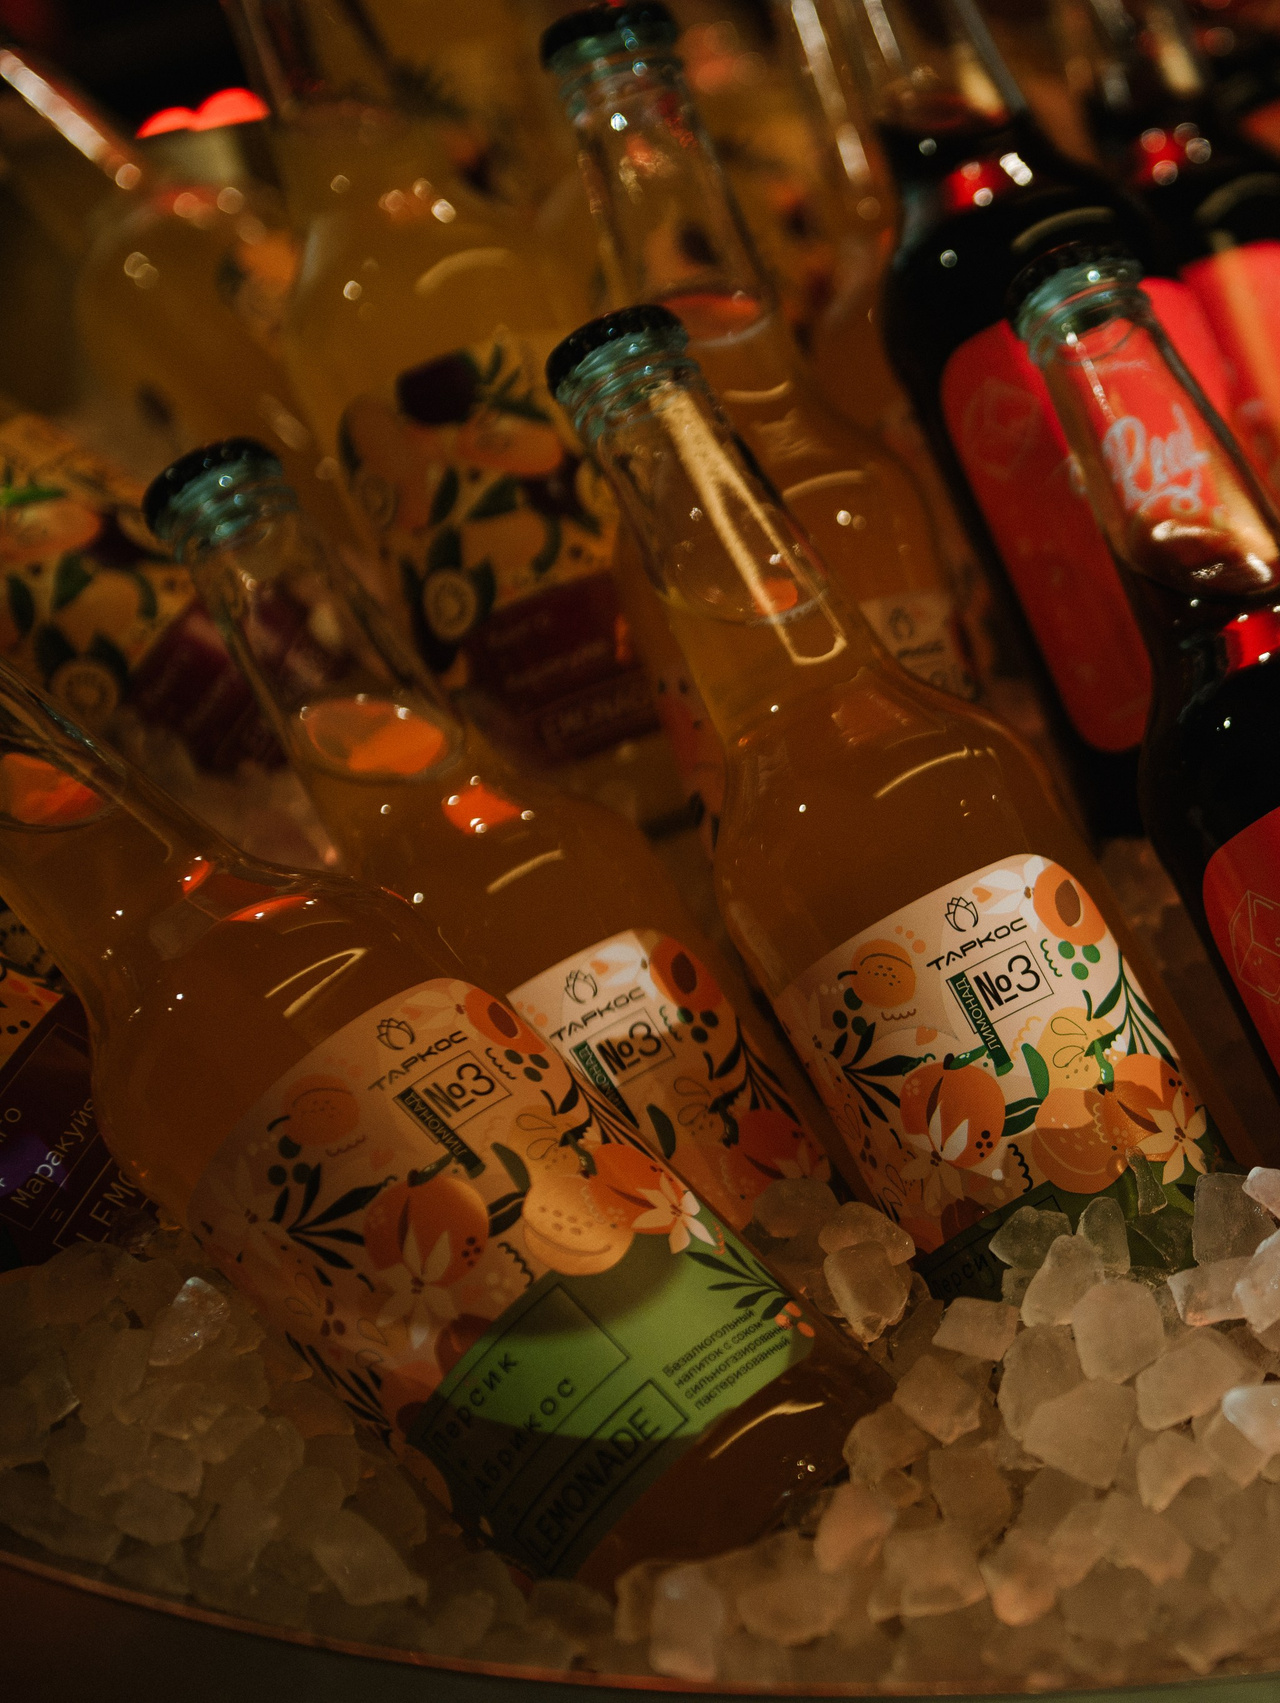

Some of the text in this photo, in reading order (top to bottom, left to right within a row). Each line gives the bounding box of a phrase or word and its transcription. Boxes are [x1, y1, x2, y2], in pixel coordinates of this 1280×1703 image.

[926, 917, 1028, 971] ТАРКОС
[973, 954, 1042, 1011] №3
[548, 986, 647, 1042] ТАРКОС
[955, 977, 1001, 1051] ЛИМОНАД
[367, 1030, 469, 1092] ТАРКОС
[596, 1021, 662, 1076] №3
[422, 1063, 496, 1119] №3
[403, 1090, 468, 1156] ЛИМОНАД
[929, 1252, 996, 1299] Перси
[431, 1352, 518, 1453] Персик
[470, 1378, 577, 1495] Абрикос
[528, 1407, 663, 1558] LEMONADE
